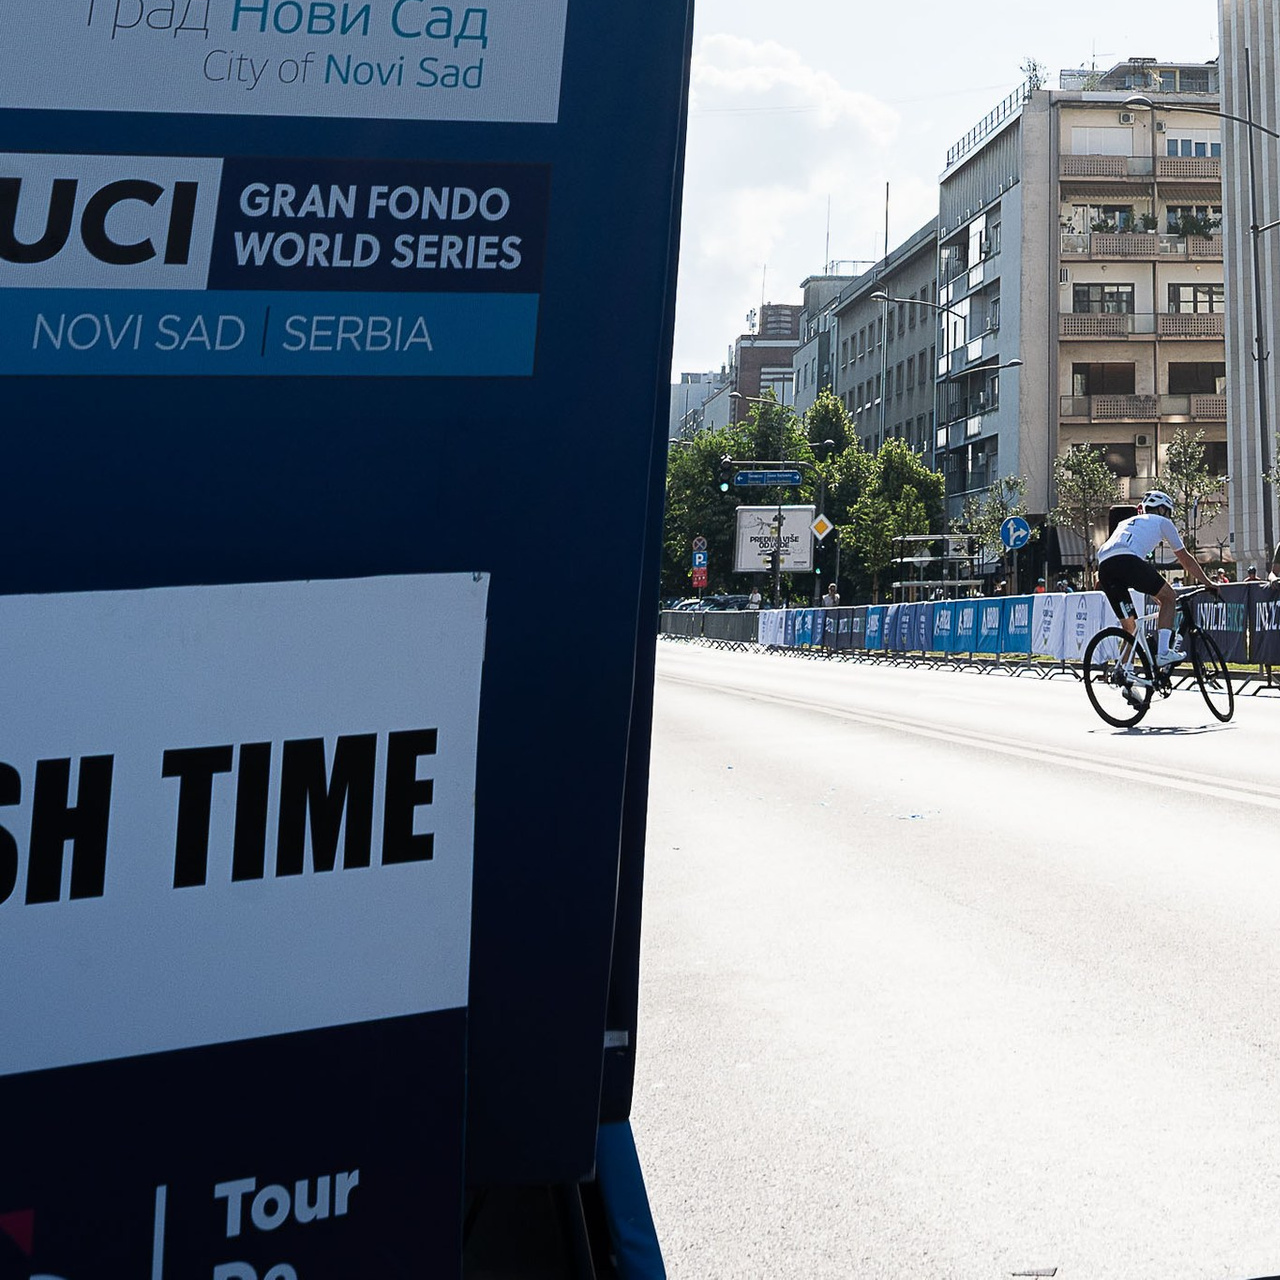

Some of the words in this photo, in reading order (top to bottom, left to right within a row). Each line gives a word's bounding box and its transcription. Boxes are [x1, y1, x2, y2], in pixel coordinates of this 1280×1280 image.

[203, 49, 268, 90] City
[278, 51, 315, 83] of
[325, 53, 404, 87] Novi
[417, 56, 484, 89] Sad
[0, 177, 199, 265] UCI
[240, 182, 357, 219] GRAN
[368, 186, 510, 222] FONDO
[234, 231, 380, 269] WORLD
[391, 235, 522, 271] SERIES
[32, 313, 142, 351] NOVI
[155, 314, 246, 351] SAD
[282, 315, 433, 352] SERBIA
[162, 728, 438, 889] TIME
[214, 1169, 359, 1238] Tour
